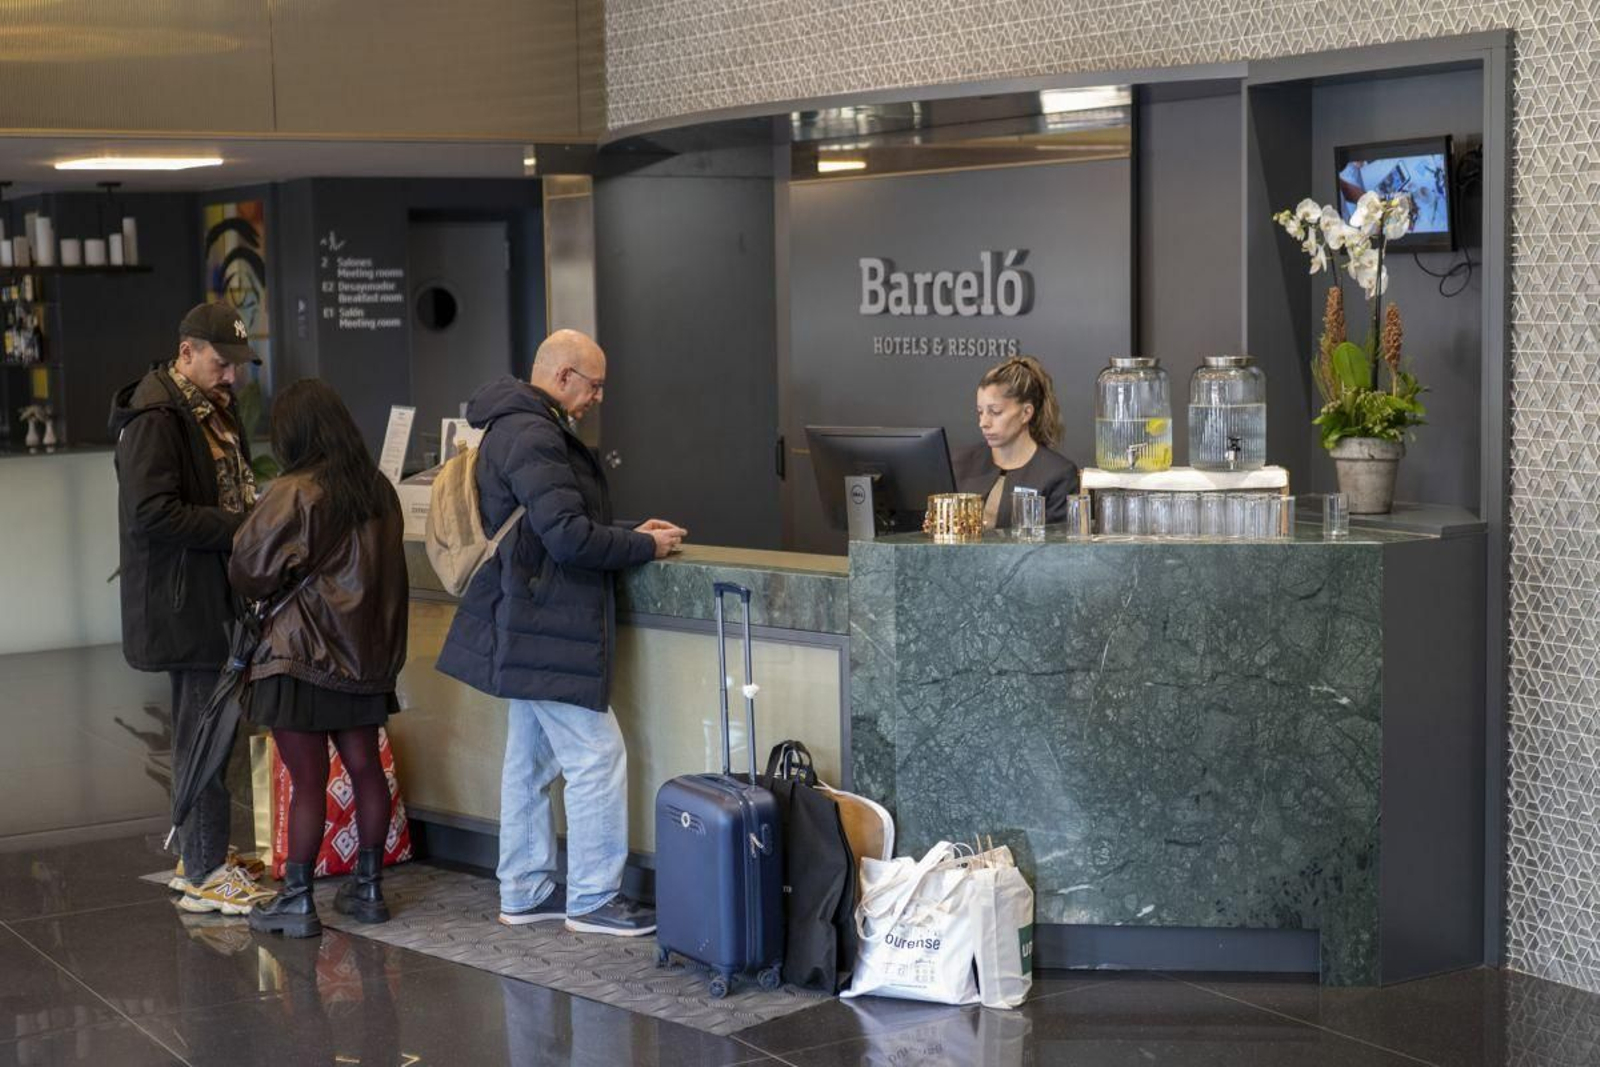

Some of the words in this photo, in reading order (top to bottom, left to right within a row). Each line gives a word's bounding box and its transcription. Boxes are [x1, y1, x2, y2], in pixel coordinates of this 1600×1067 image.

[321, 257, 328, 268] 2
[337, 257, 373, 267] Salones
[337, 268, 374, 279] Meeting
[376, 269, 404, 278] rooms
[322, 281, 333, 292] E2
[859, 249, 1024, 316] Barceló
[380, 293, 402, 303] room
[323, 307, 333, 318] E1
[339, 307, 364, 317] Salón
[339, 319, 375, 330] Meeting
[377, 318, 402, 328] room
[874, 337, 928, 354] HOTELS
[933, 338, 943, 354] &
[949, 338, 1018, 357] RESORTS
